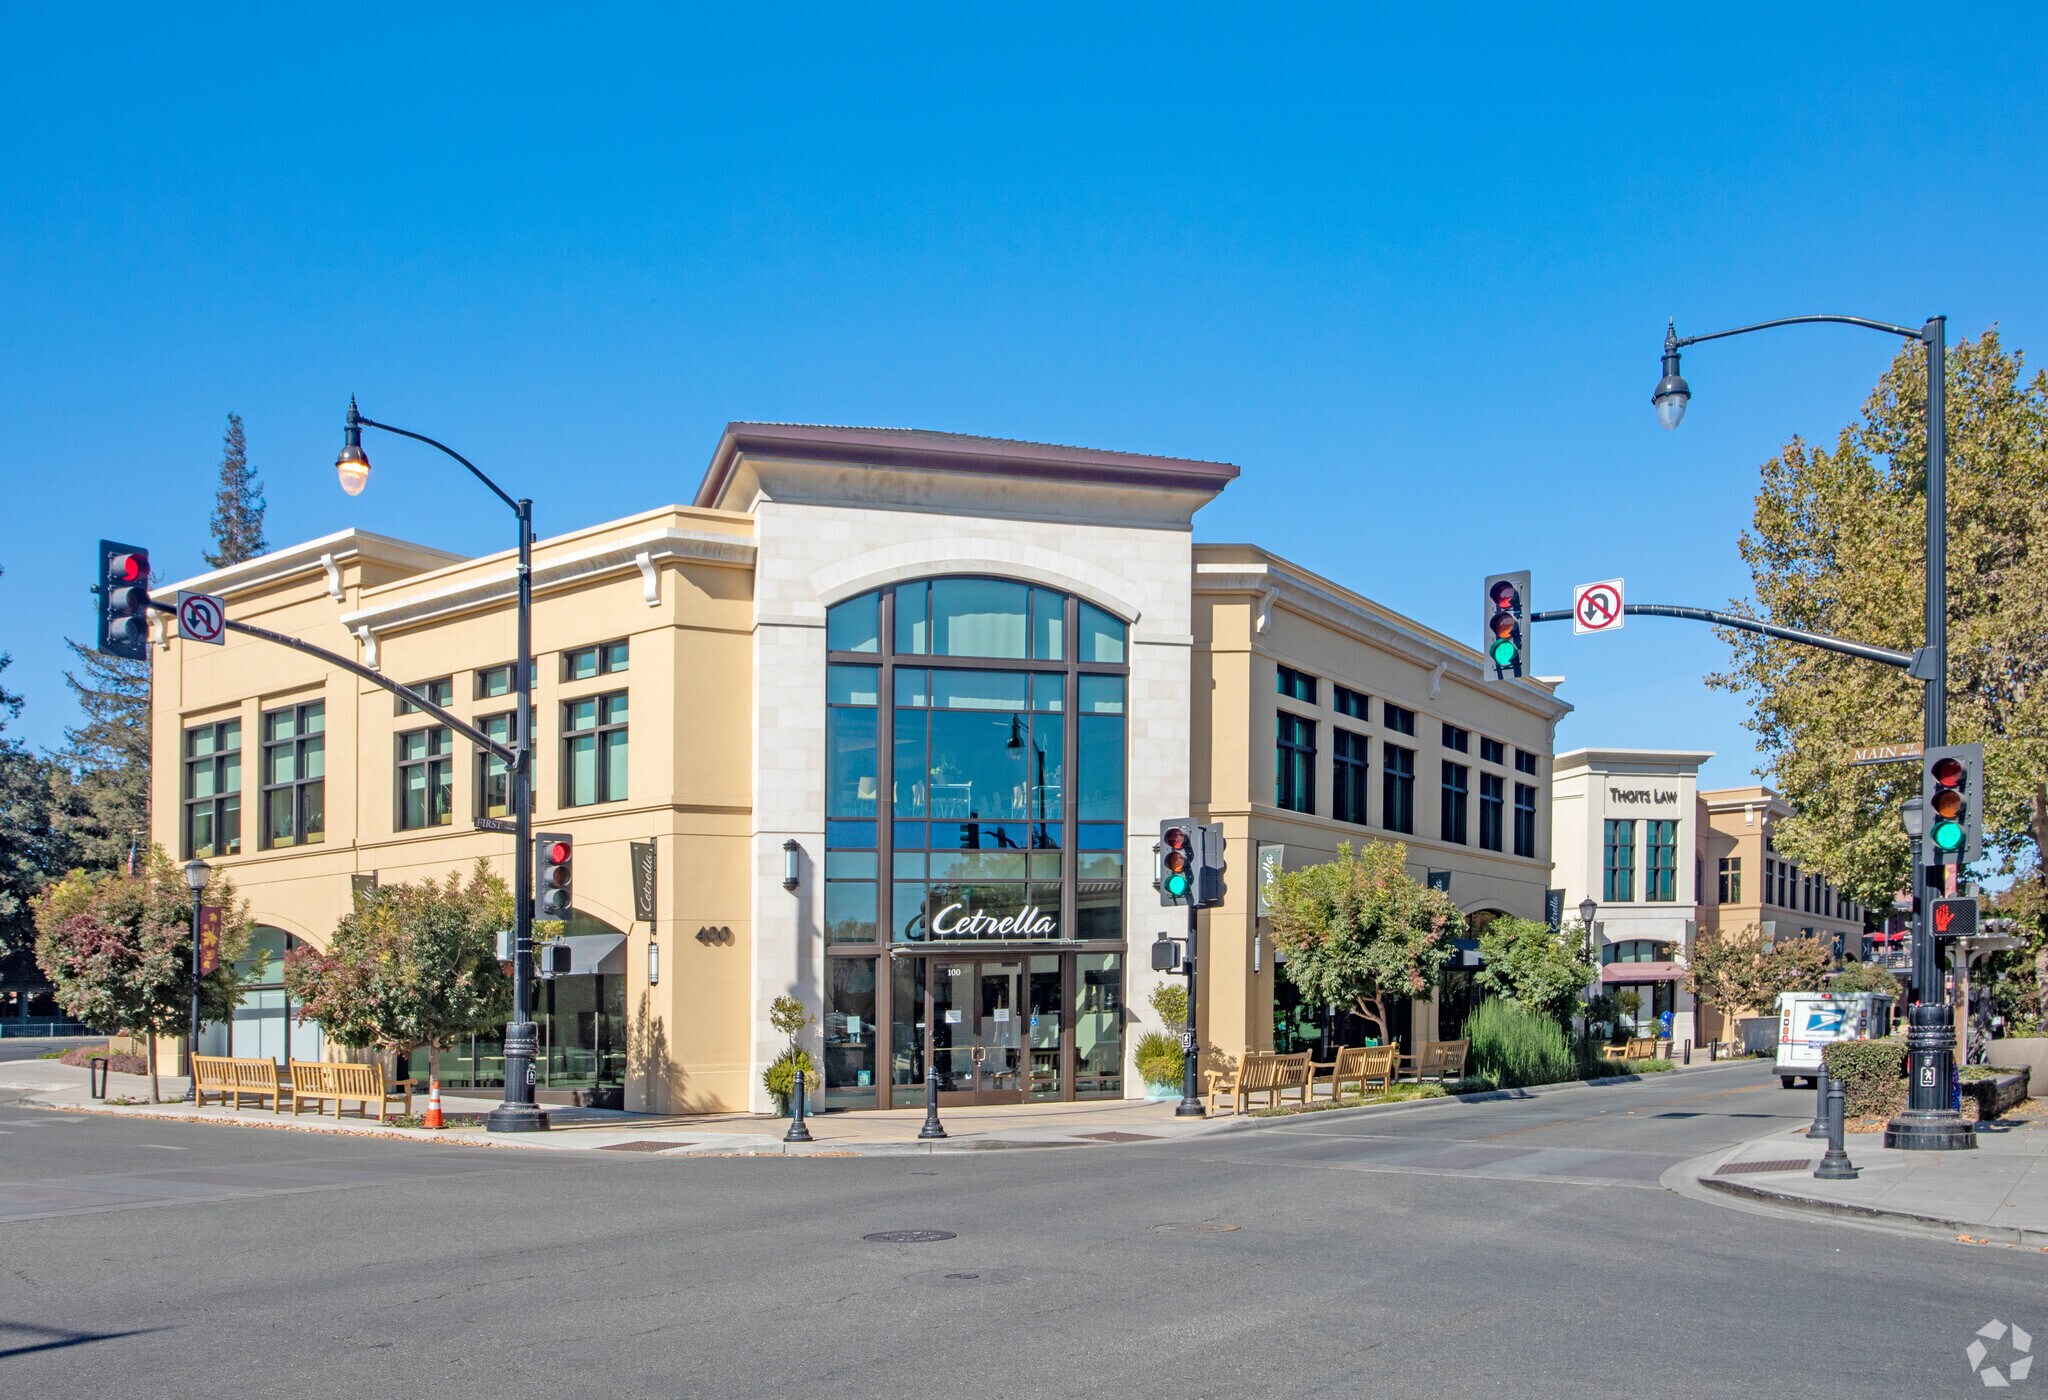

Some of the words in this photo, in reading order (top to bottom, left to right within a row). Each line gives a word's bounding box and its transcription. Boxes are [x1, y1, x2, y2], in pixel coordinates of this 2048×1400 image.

[1853, 746, 1898, 761] MAIN
[476, 818, 502, 829] FIRST
[640, 852, 653, 912] Cetrella
[932, 903, 1056, 934] Cetrella
[694, 926, 731, 943] 400
[947, 968, 961, 977] 100
